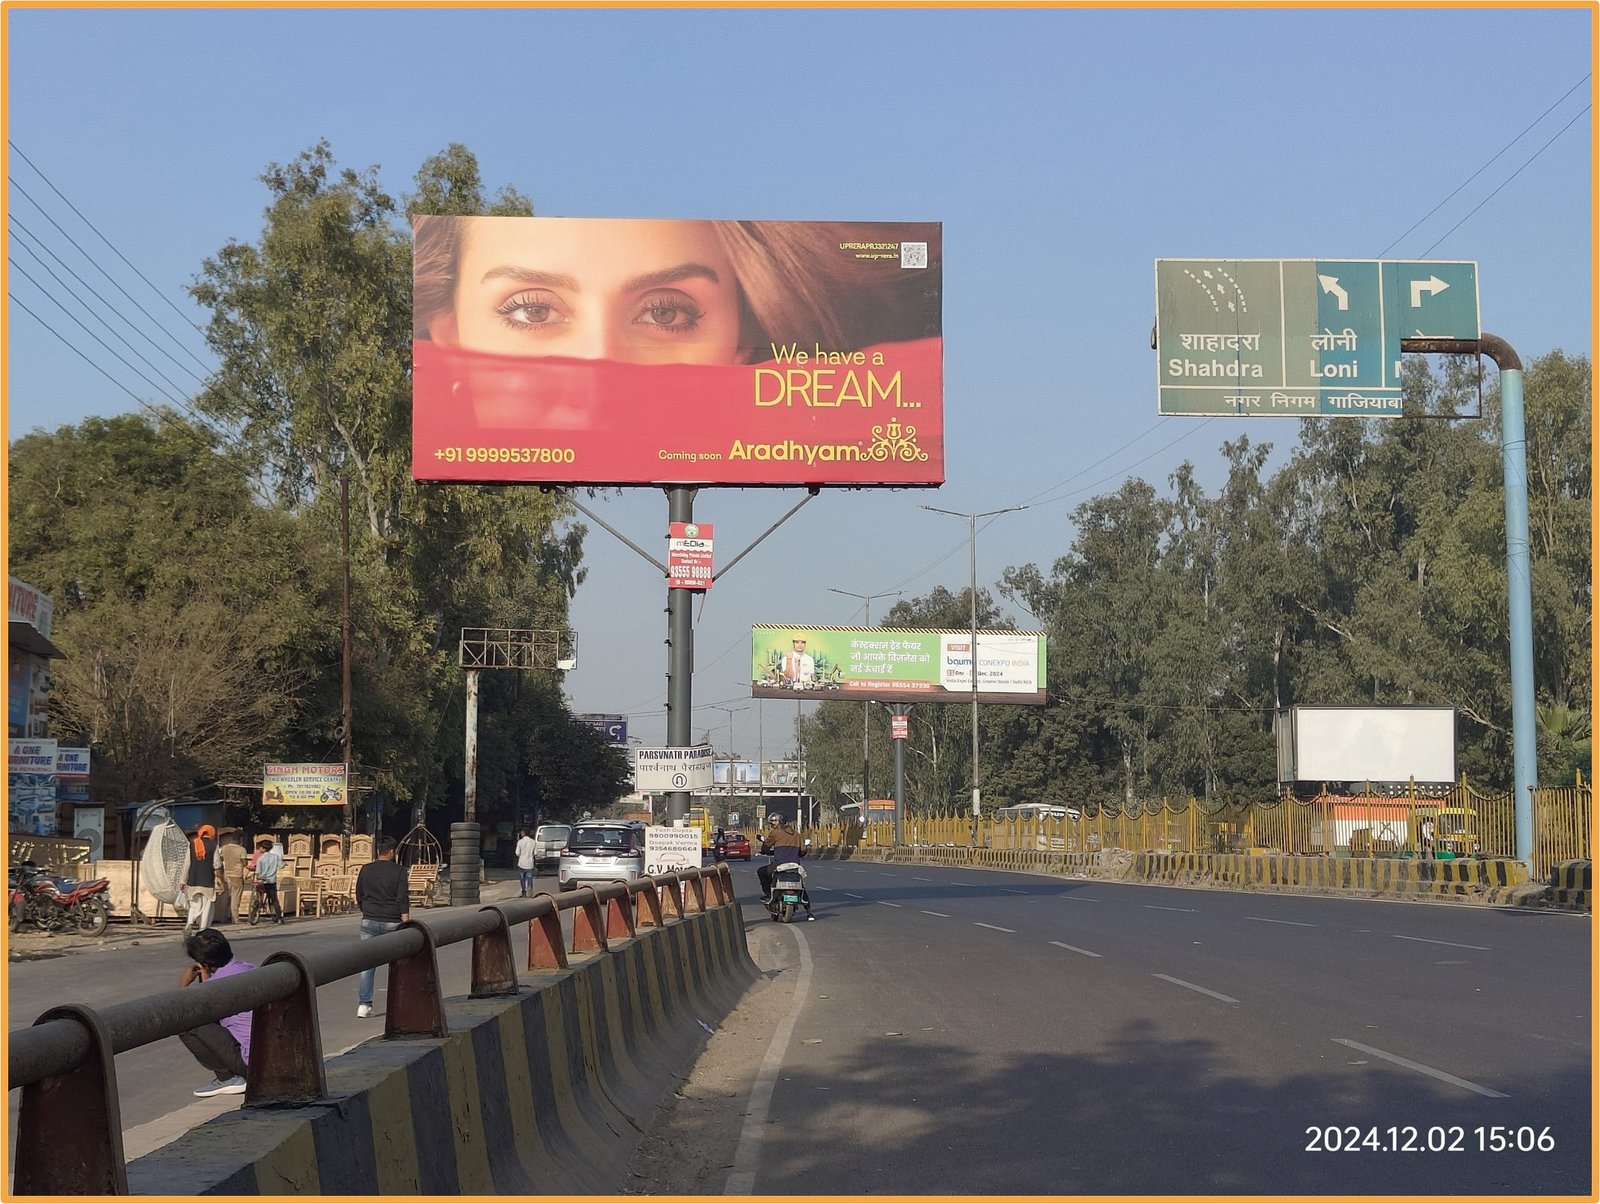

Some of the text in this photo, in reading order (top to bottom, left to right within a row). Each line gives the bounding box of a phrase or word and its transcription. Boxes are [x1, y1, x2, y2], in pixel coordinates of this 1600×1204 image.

[1179, 331, 1261, 352] शाहादरा
[1310, 327, 1358, 352] लोनी
[771, 342, 885, 366] We have a
[1168, 359, 1264, 379] Shahdra
[1310, 360, 1358, 379] Loni
[754, 368, 922, 408] DREAM...
[1223, 391, 1403, 410] नगर निगम गाजियाबा
[434, 447, 575, 464] +91 9999537800
[658, 449, 722, 463] Coming soon
[728, 439, 860, 466] Aradhyam
[947, 656, 976, 667] baum
[867, 681, 891, 689] Register
[13, 745, 42, 755] A ONE
[58, 753, 79, 762] A ONE
[266, 766, 345, 775] SINGH MOTORS
